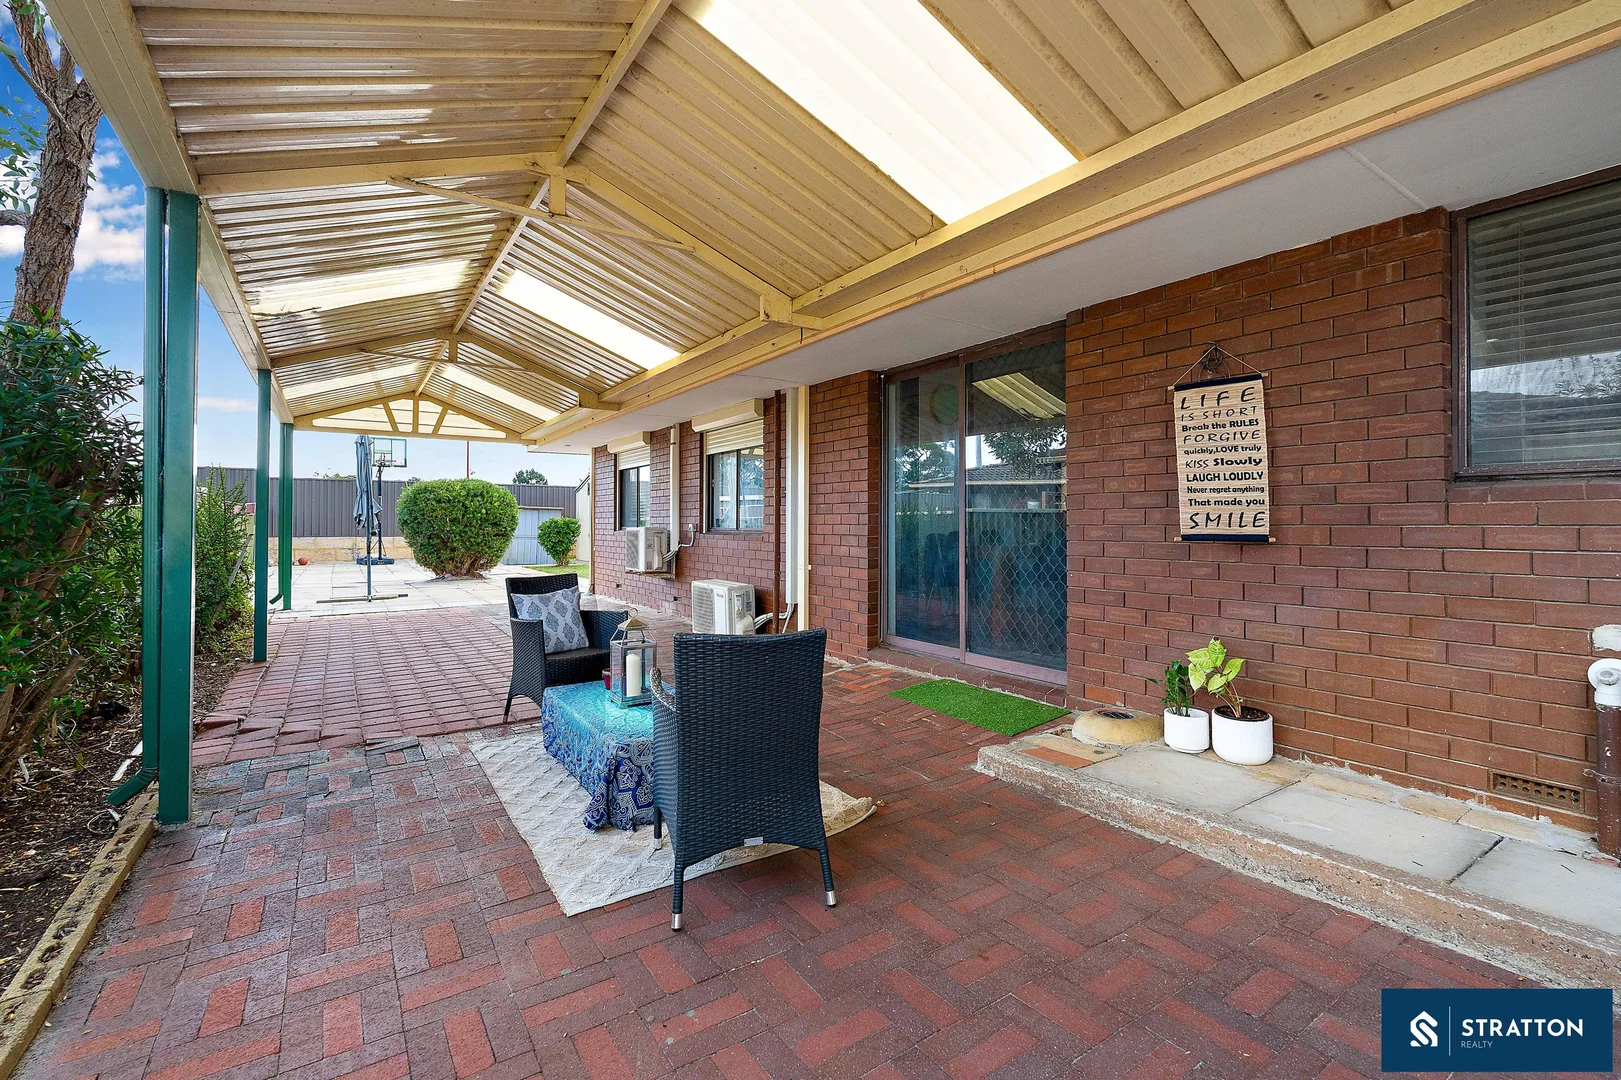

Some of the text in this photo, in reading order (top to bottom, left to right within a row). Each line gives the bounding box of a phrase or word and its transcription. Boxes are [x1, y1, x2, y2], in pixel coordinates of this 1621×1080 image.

[1180, 386, 1256, 410] LIFE
[1181, 406, 1257, 422] IS SHORT
[1182, 418, 1259, 432] Break the RULES
[1183, 430, 1260, 444] FORGIVE
[1241, 444, 1262, 452] truly
[1185, 457, 1263, 469] KISS Slowly
[1186, 471, 1263, 482] LAUGH LOUDLY
[1187, 486, 1265, 494] Never regret anything
[1188, 498, 1265, 507] That made you
[1189, 511, 1266, 529] SMILE
